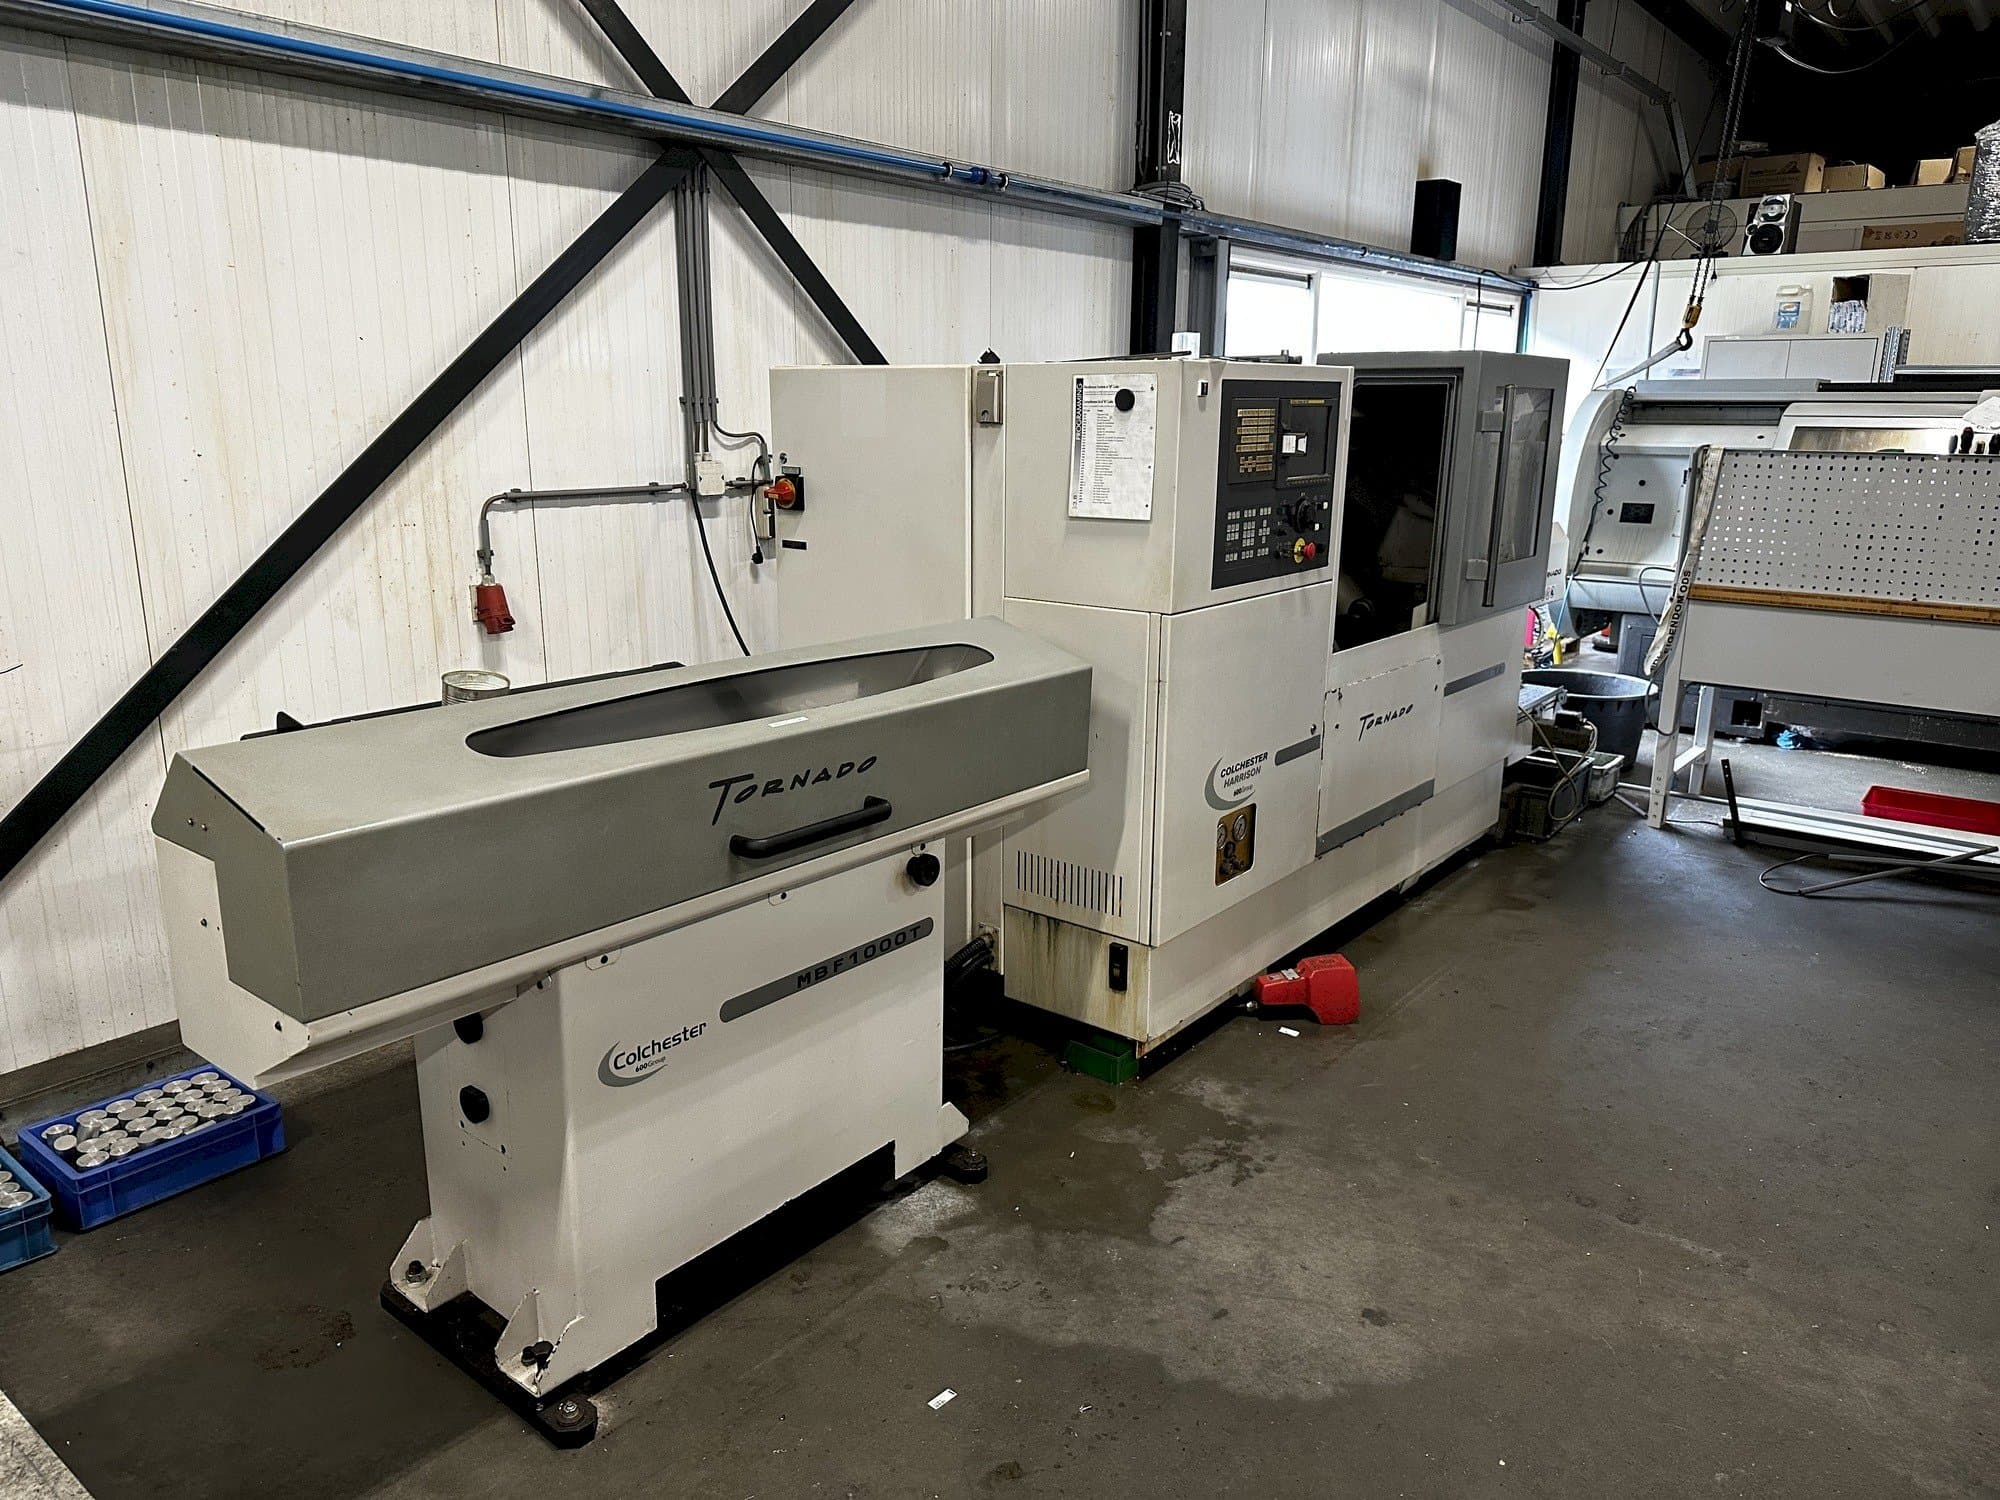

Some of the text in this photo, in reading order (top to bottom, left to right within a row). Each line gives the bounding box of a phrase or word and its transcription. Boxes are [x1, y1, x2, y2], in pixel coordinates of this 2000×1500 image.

[1679, 570, 1691, 594] ODS
[1358, 703, 1414, 742] TORNADO
[1220, 751, 1268, 778] COLCHESTER
[1223, 765, 1262, 789] HARRISON
[708, 755, 878, 827] TORNADO
[797, 925, 921, 989] MBF1000T
[613, 1022, 707, 1071] Colchester
